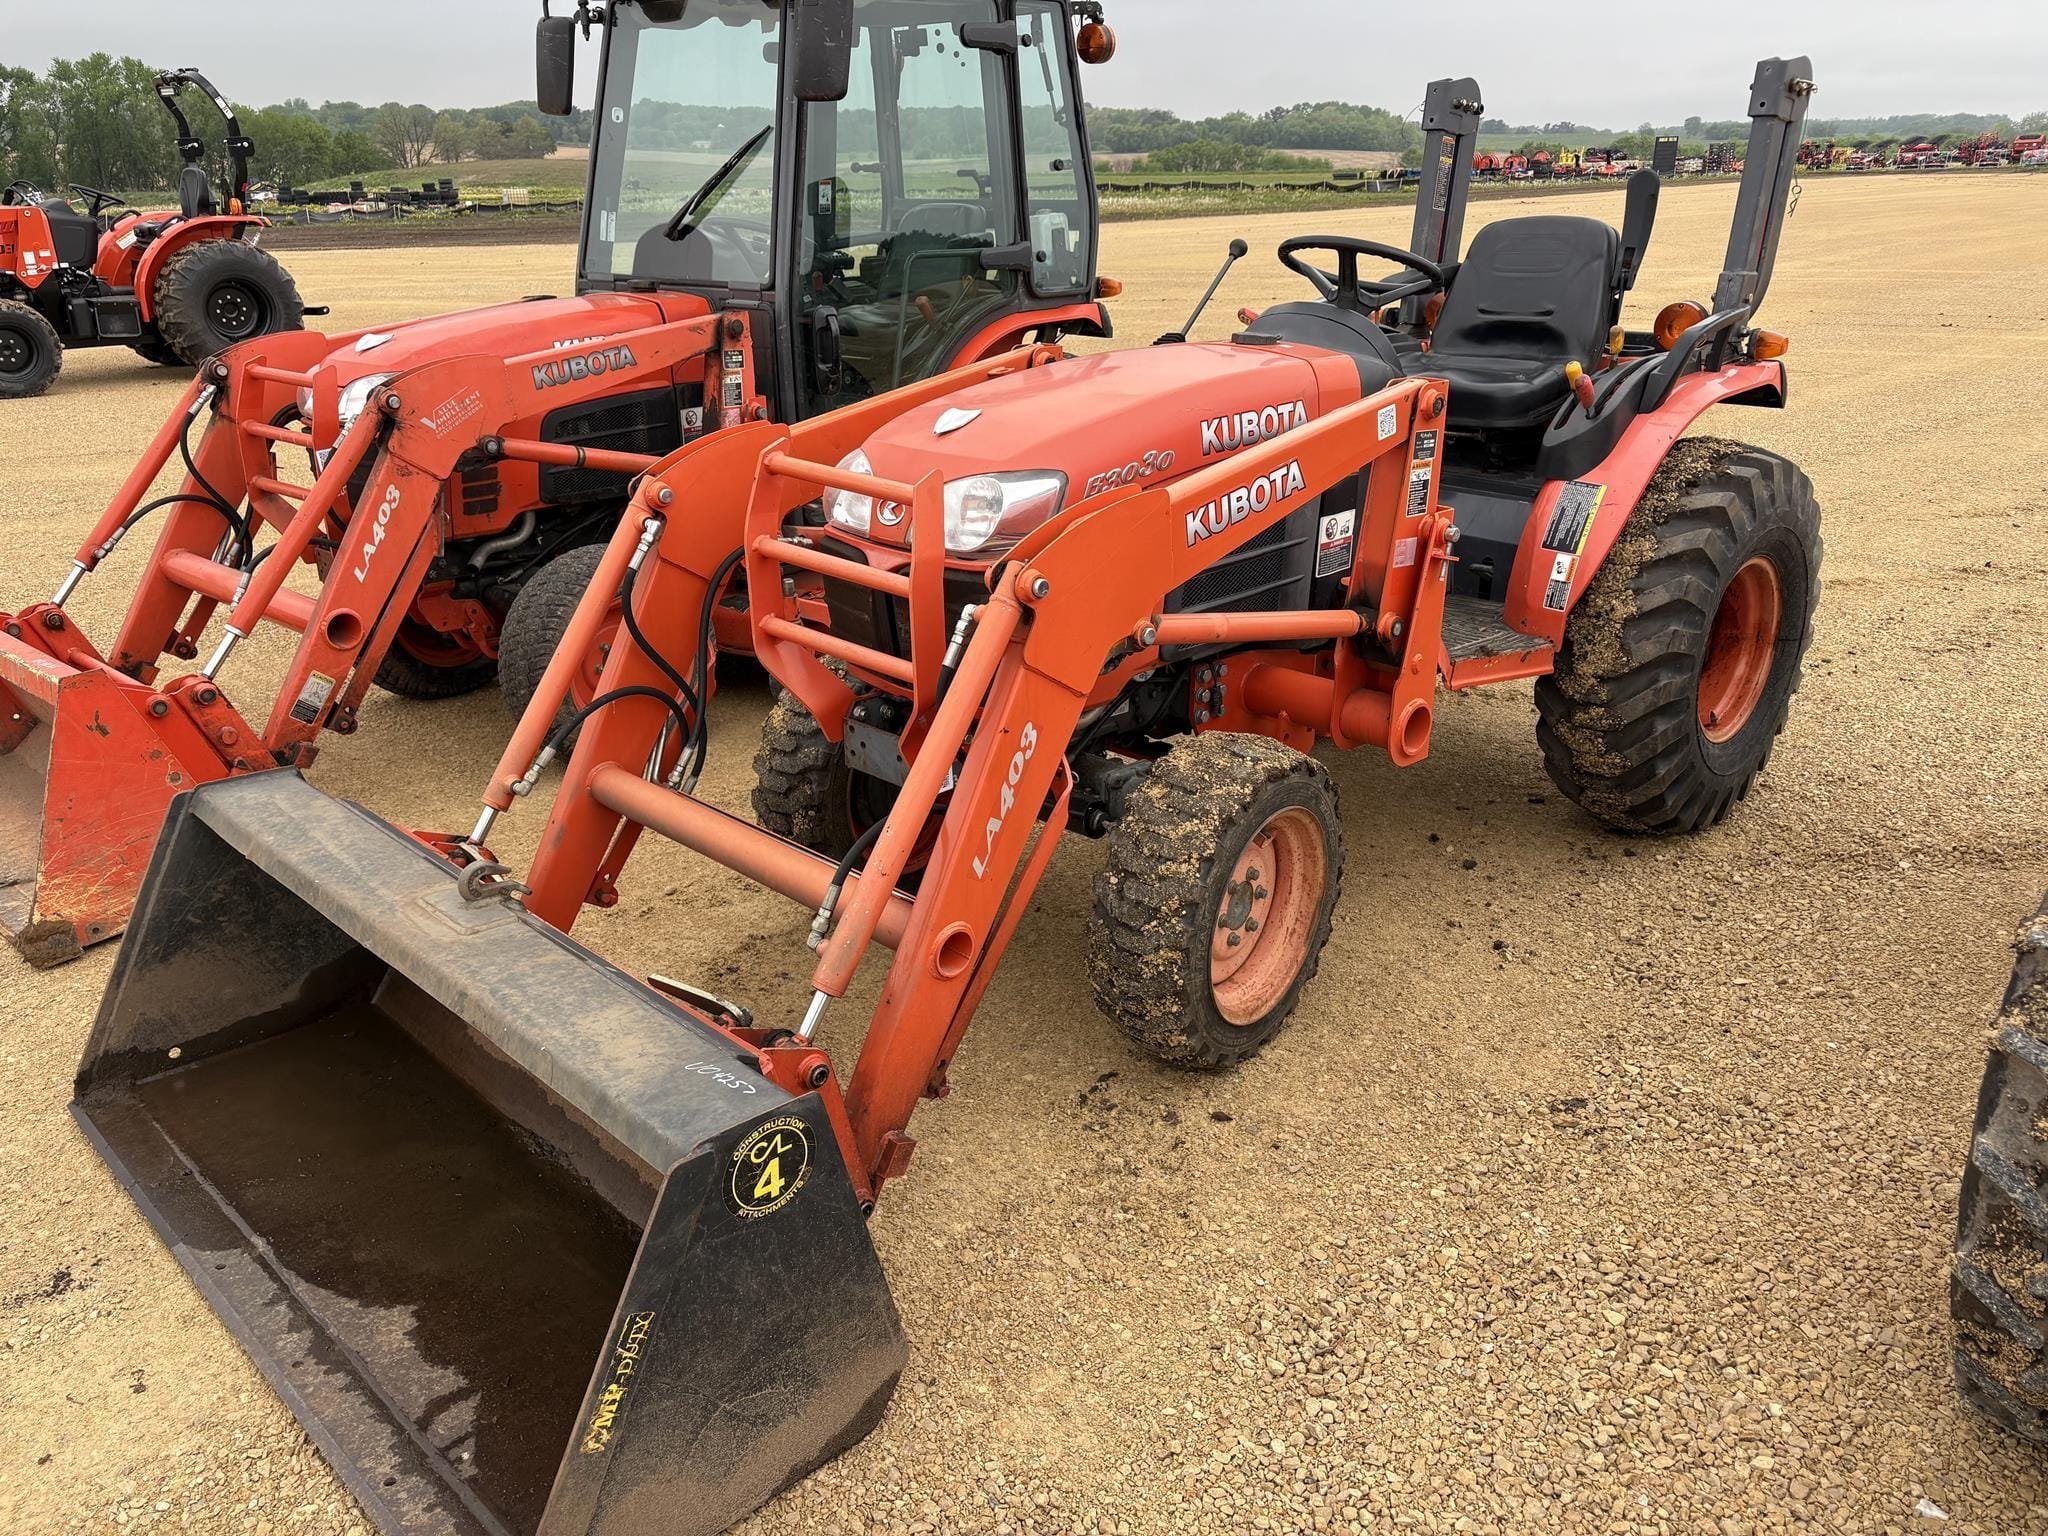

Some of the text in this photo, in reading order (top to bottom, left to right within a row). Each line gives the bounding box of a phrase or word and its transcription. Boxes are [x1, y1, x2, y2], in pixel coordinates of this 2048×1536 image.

[532, 344, 637, 390] KUBOTA
[1200, 400, 1309, 456] KUBOTA
[1083, 450, 1175, 499] B3030
[1185, 458, 1307, 547] KUBOTA
[353, 483, 401, 584] LA403
[972, 721, 1038, 879] LA403
[733, 1117, 807, 1161] CONSTRUCTION
[737, 1179, 804, 1220] ATTACHMENTS
[754, 1157, 786, 1199] 4
